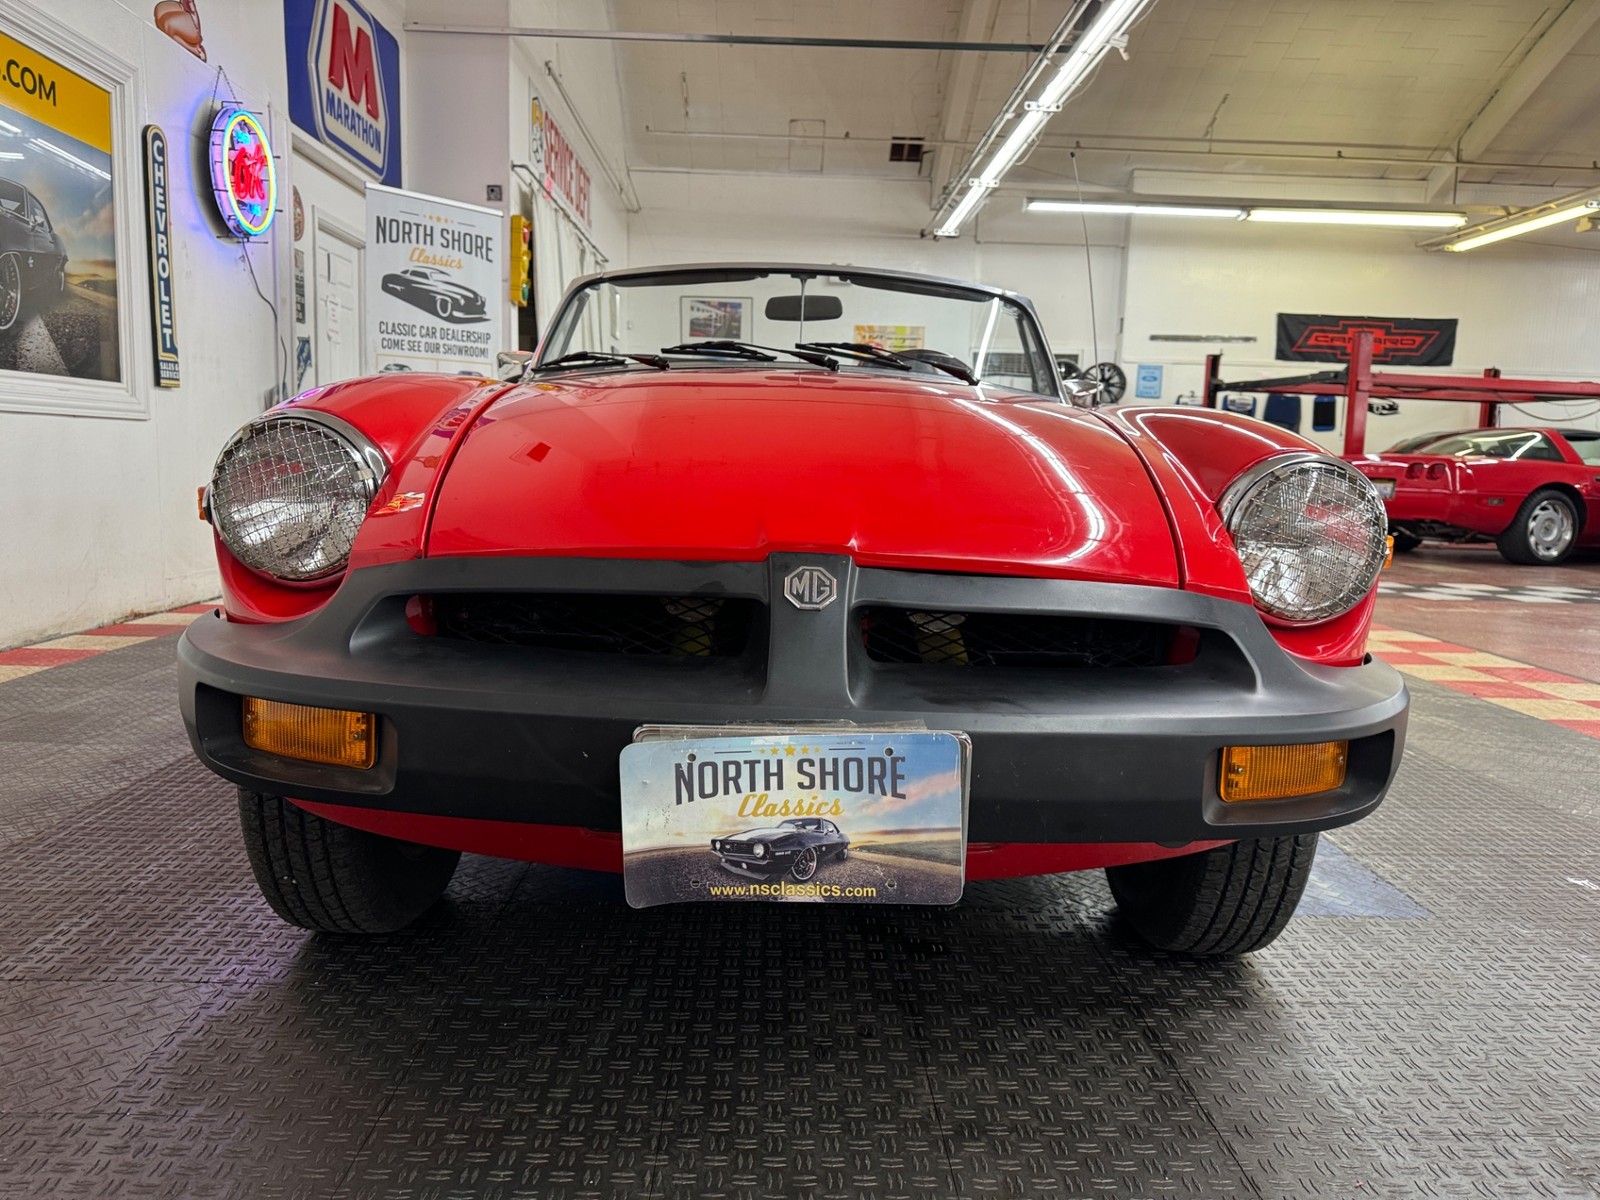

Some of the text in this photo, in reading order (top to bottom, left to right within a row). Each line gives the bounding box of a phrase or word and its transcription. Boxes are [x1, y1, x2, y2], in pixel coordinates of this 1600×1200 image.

[326, 87, 381, 154] MARATHON
[153, 140, 173, 349] CHEVROLET
[375, 215, 494, 264] NORTH SHORE
[408, 247, 464, 270] Classics
[379, 321, 492, 345] CLASSIC CAR DEALERSHIP
[381, 337, 489, 359] COME SEE OUR SHOWROOM!
[792, 571, 830, 603] MG
[674, 755, 906, 806] NORTH SHORE
[737, 793, 844, 819] Classics
[710, 881, 877, 897] www.nsclassics.com
